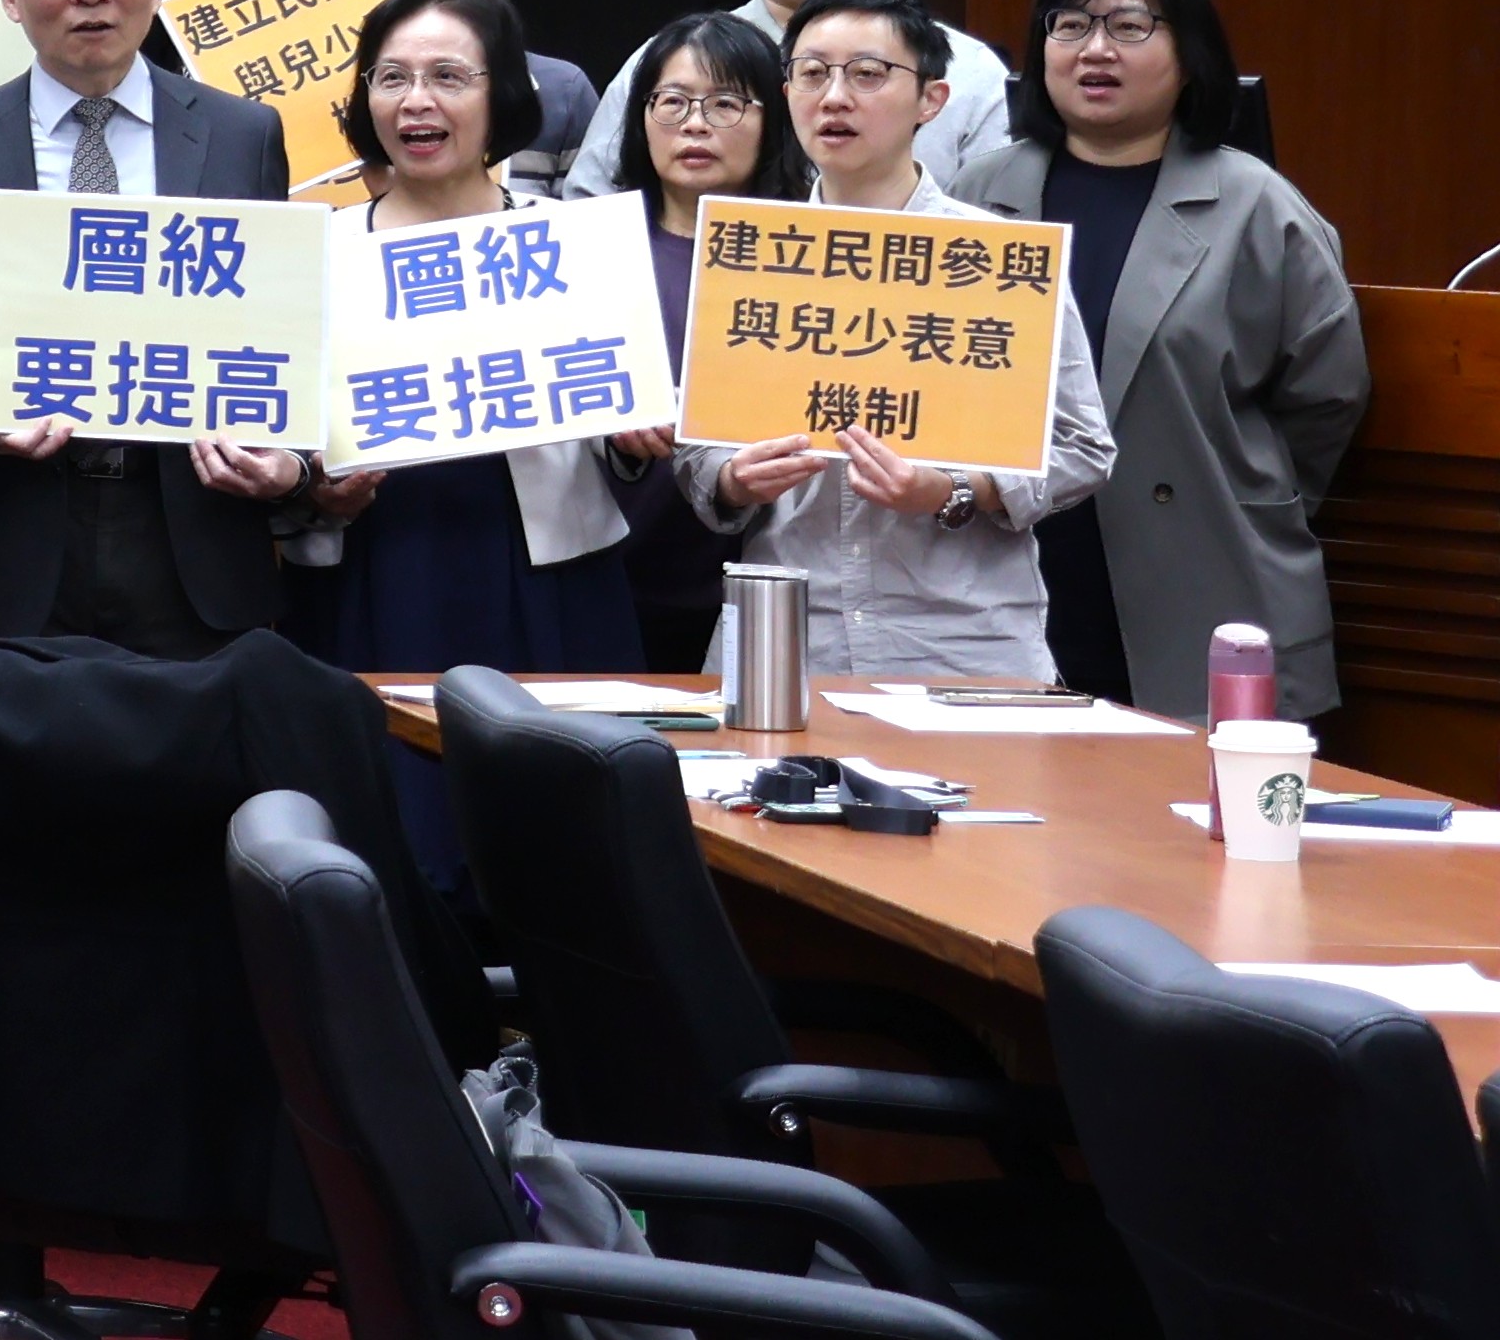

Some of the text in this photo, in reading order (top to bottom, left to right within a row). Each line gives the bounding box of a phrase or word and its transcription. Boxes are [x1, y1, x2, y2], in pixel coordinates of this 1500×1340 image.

[63, 208, 247, 299] 層級
[383, 218, 569, 320] 層級
[705, 218, 1052, 296] 建立民間參與
[727, 299, 1016, 372] 與兒少表意
[13, 337, 291, 434] 要提高
[348, 336, 635, 450] 要提高
[805, 381, 921, 441] 機制
